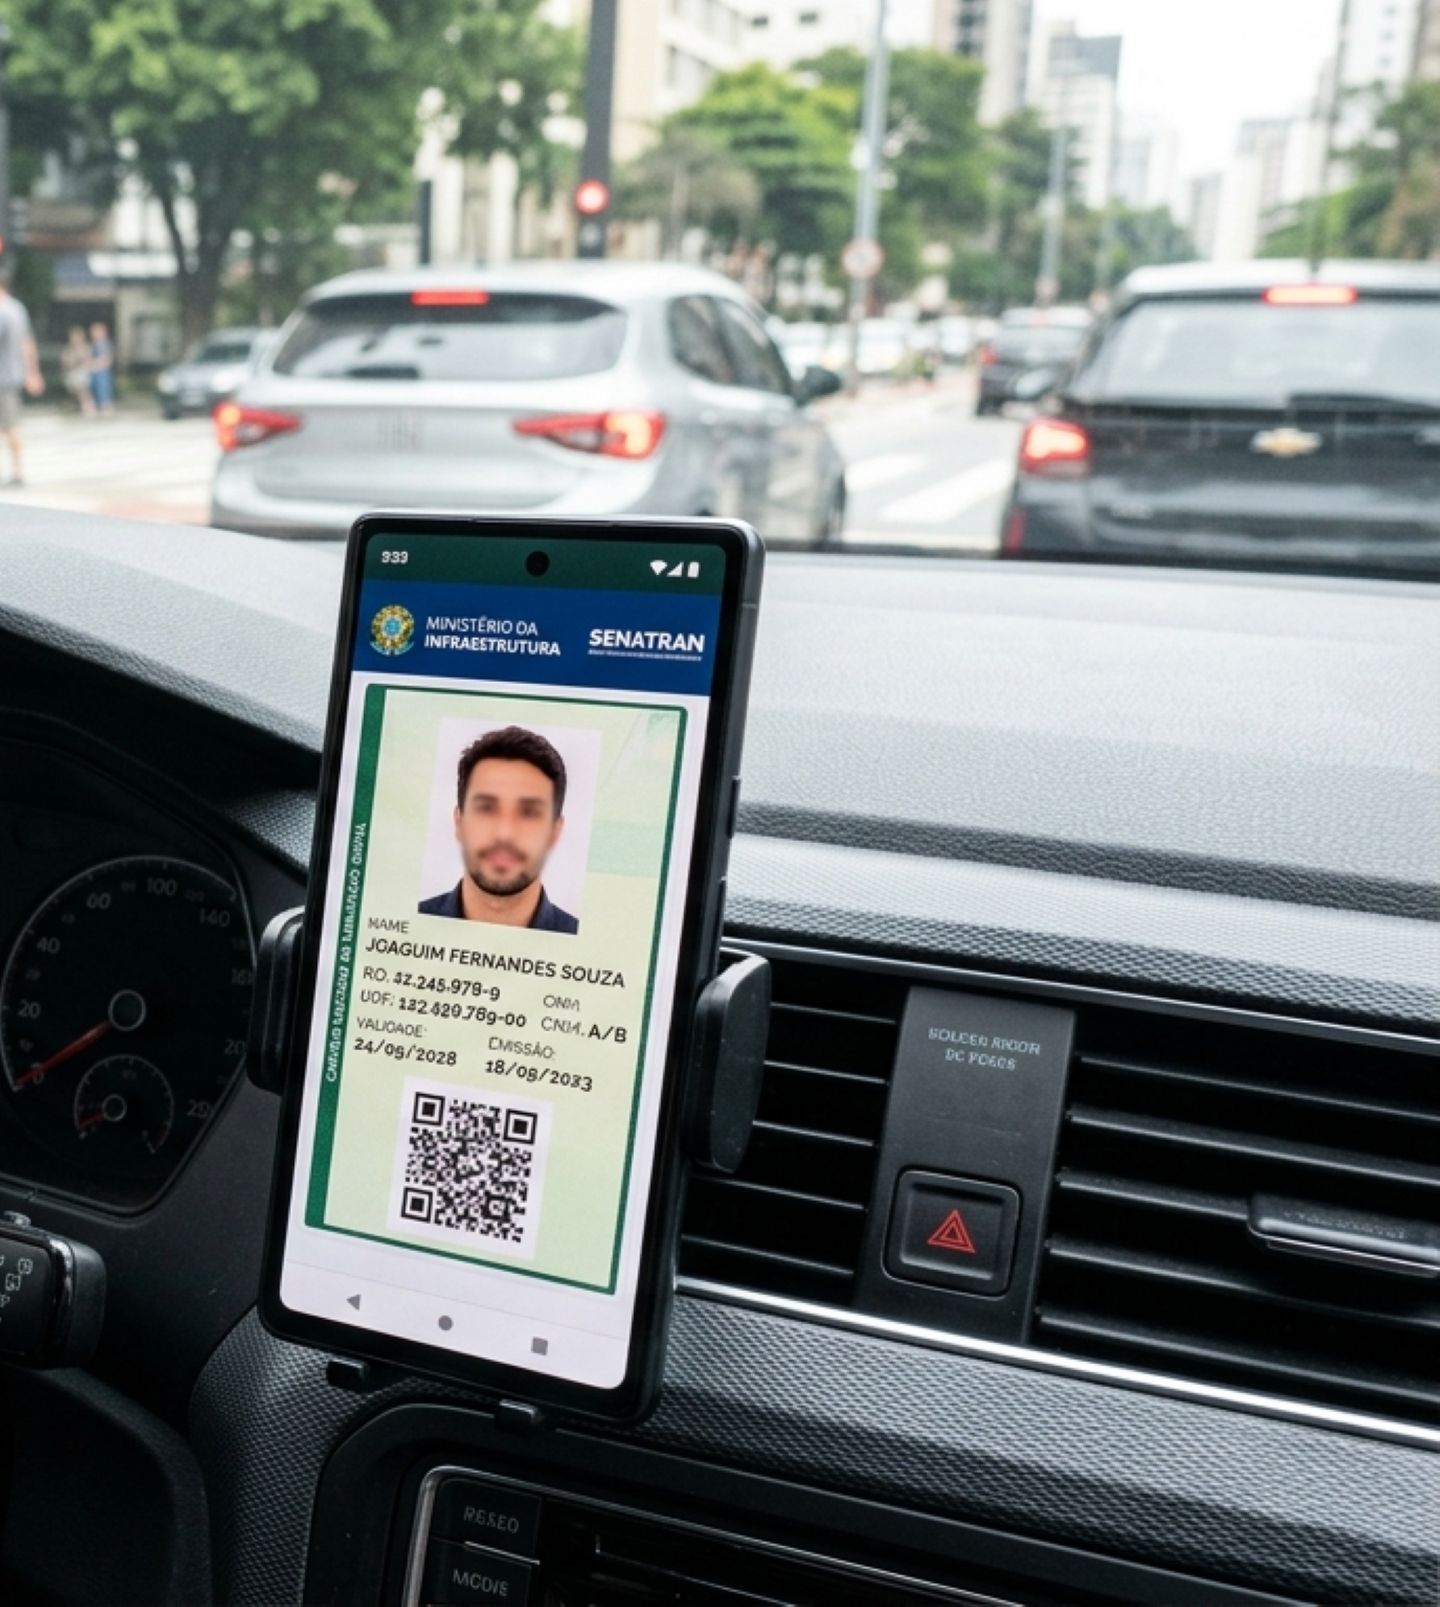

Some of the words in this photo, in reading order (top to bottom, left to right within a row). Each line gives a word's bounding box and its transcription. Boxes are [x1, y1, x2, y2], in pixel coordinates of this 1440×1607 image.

[426, 614, 513, 636] MINISTÉRIO
[423, 634, 562, 657] INFRAESTRUTURA
[588, 628, 706, 653] SENATRAN
[144, 877, 180, 898] 100
[35, 936, 62, 956] 40
[449, 948, 557, 978] FERNANDES
[561, 964, 626, 989] SOUZA
[17, 1000, 43, 1021] 20
[587, 1023, 628, 1044] A/B
